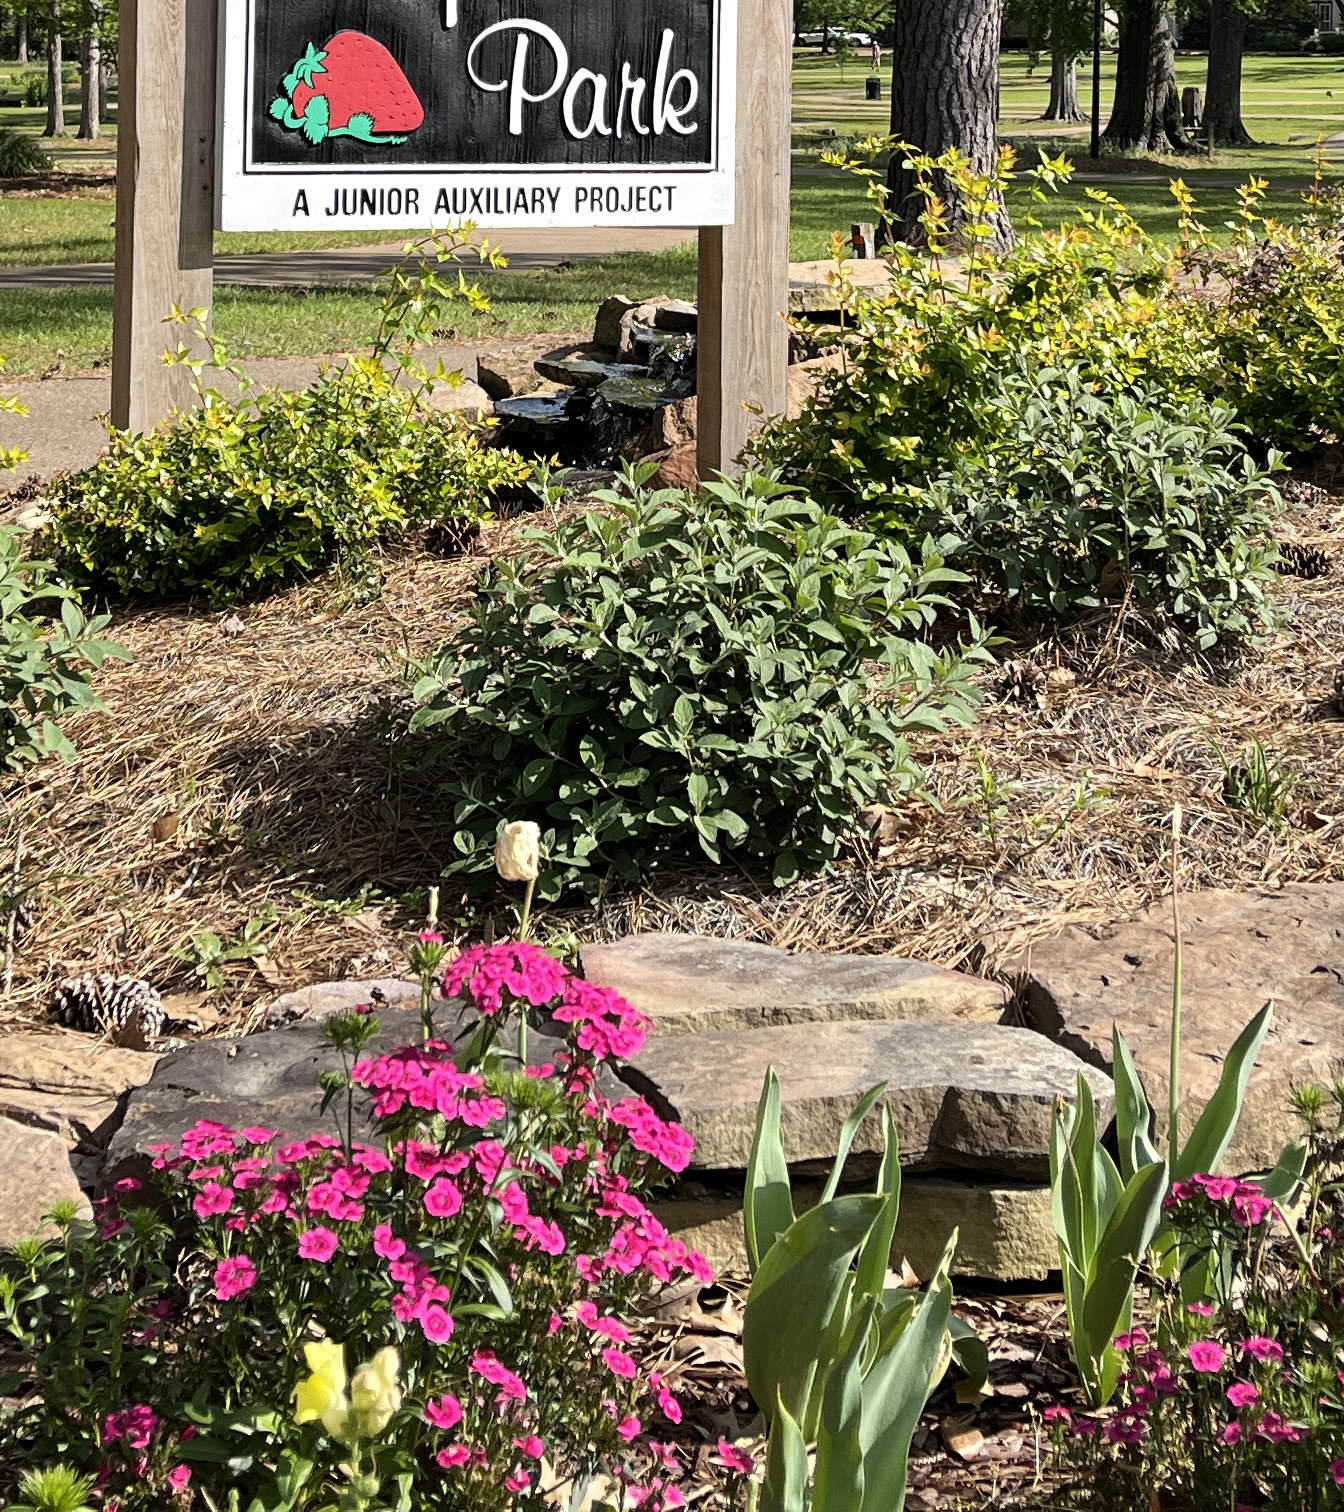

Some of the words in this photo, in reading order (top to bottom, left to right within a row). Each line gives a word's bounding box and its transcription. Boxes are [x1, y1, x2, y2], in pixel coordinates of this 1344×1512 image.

[467, 18, 699, 139] Park
[292, 187, 311, 217] A
[324, 187, 421, 217] JUNIOR
[434, 186, 562, 216] AUXILIARY
[574, 184, 678, 213] PROJECT
